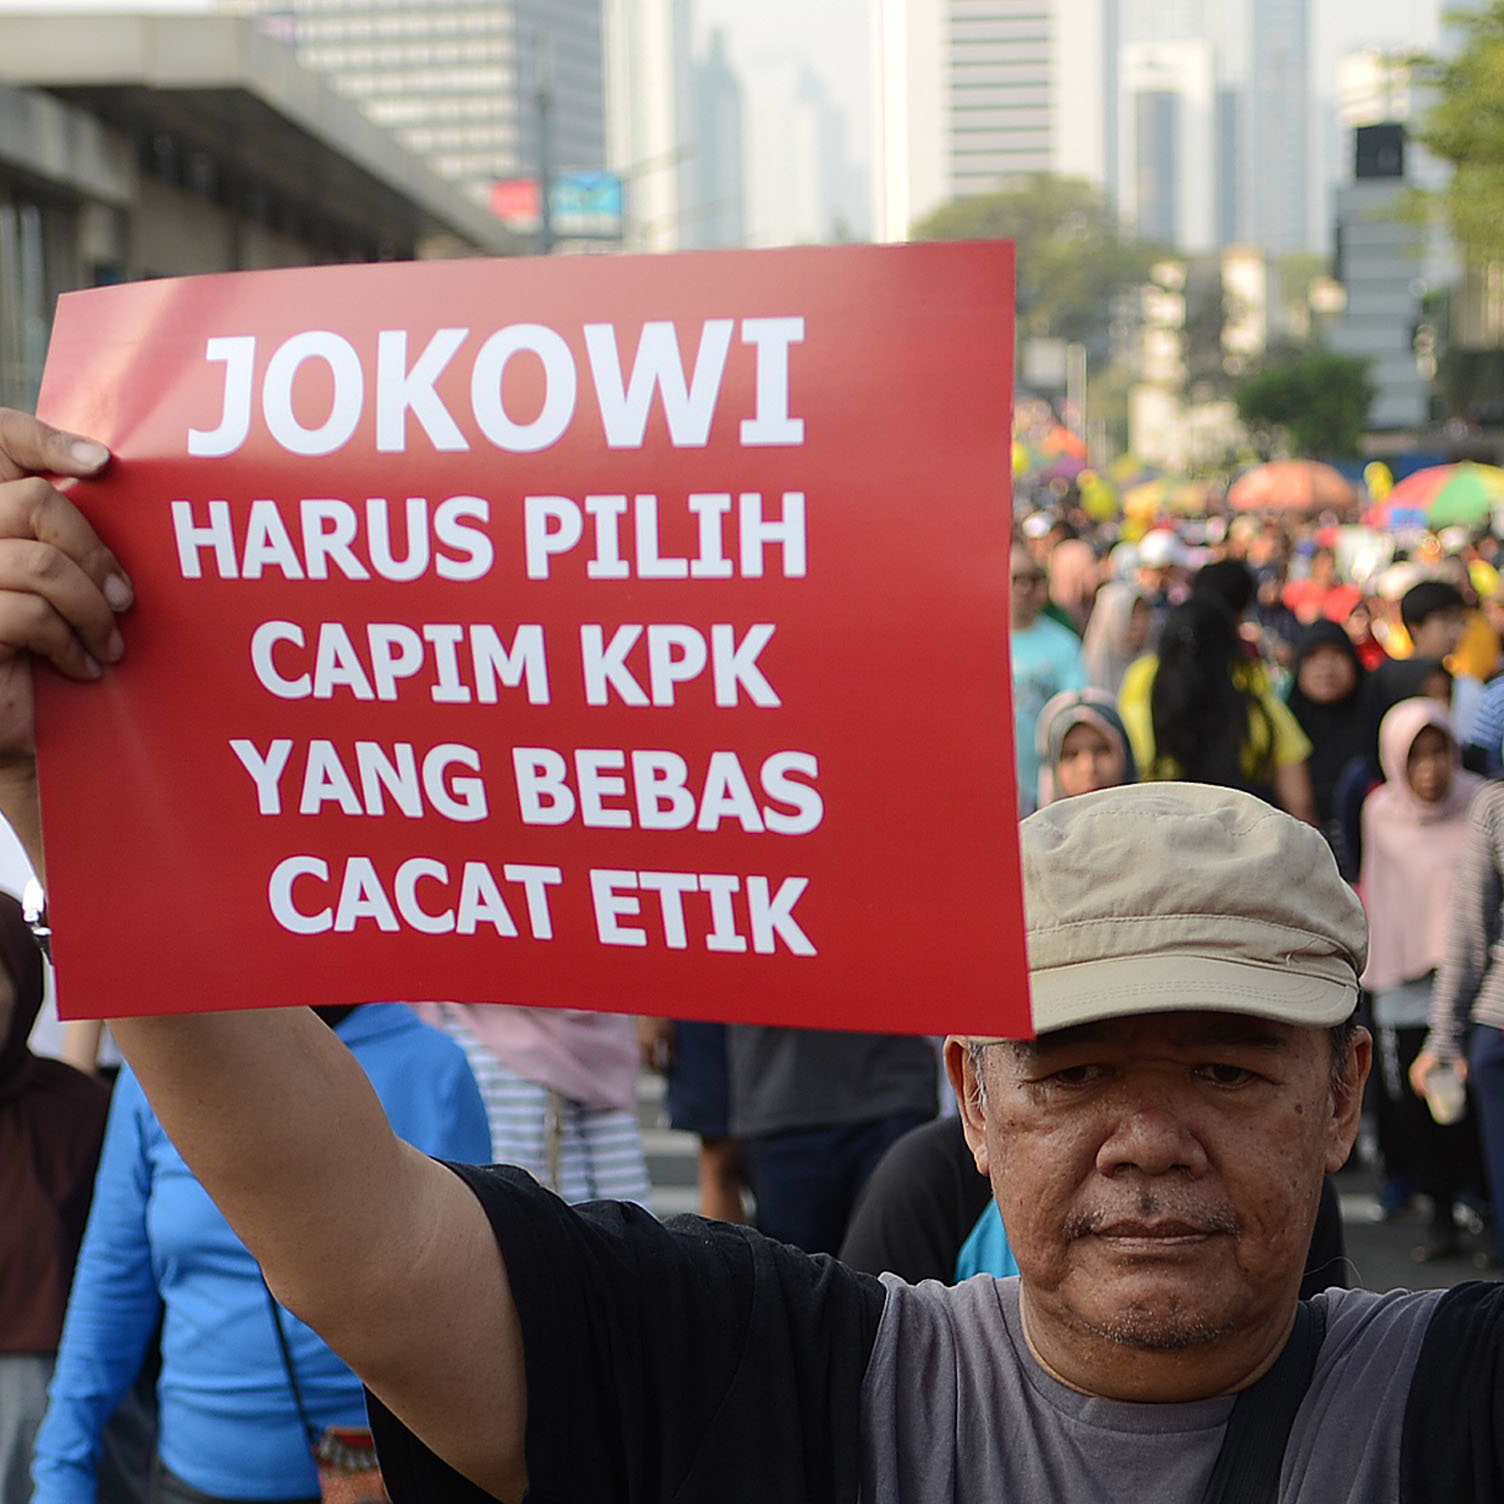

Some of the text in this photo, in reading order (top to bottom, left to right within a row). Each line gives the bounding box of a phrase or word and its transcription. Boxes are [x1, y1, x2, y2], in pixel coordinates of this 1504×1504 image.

[187, 316, 805, 457] JOKOWI
[172, 493, 806, 580] HARUS PILIH
[252, 621, 781, 706] CAPIM KPK
[230, 739, 823, 834] YANG BEBAS
[269, 857, 817, 955] CACAT ETIK
